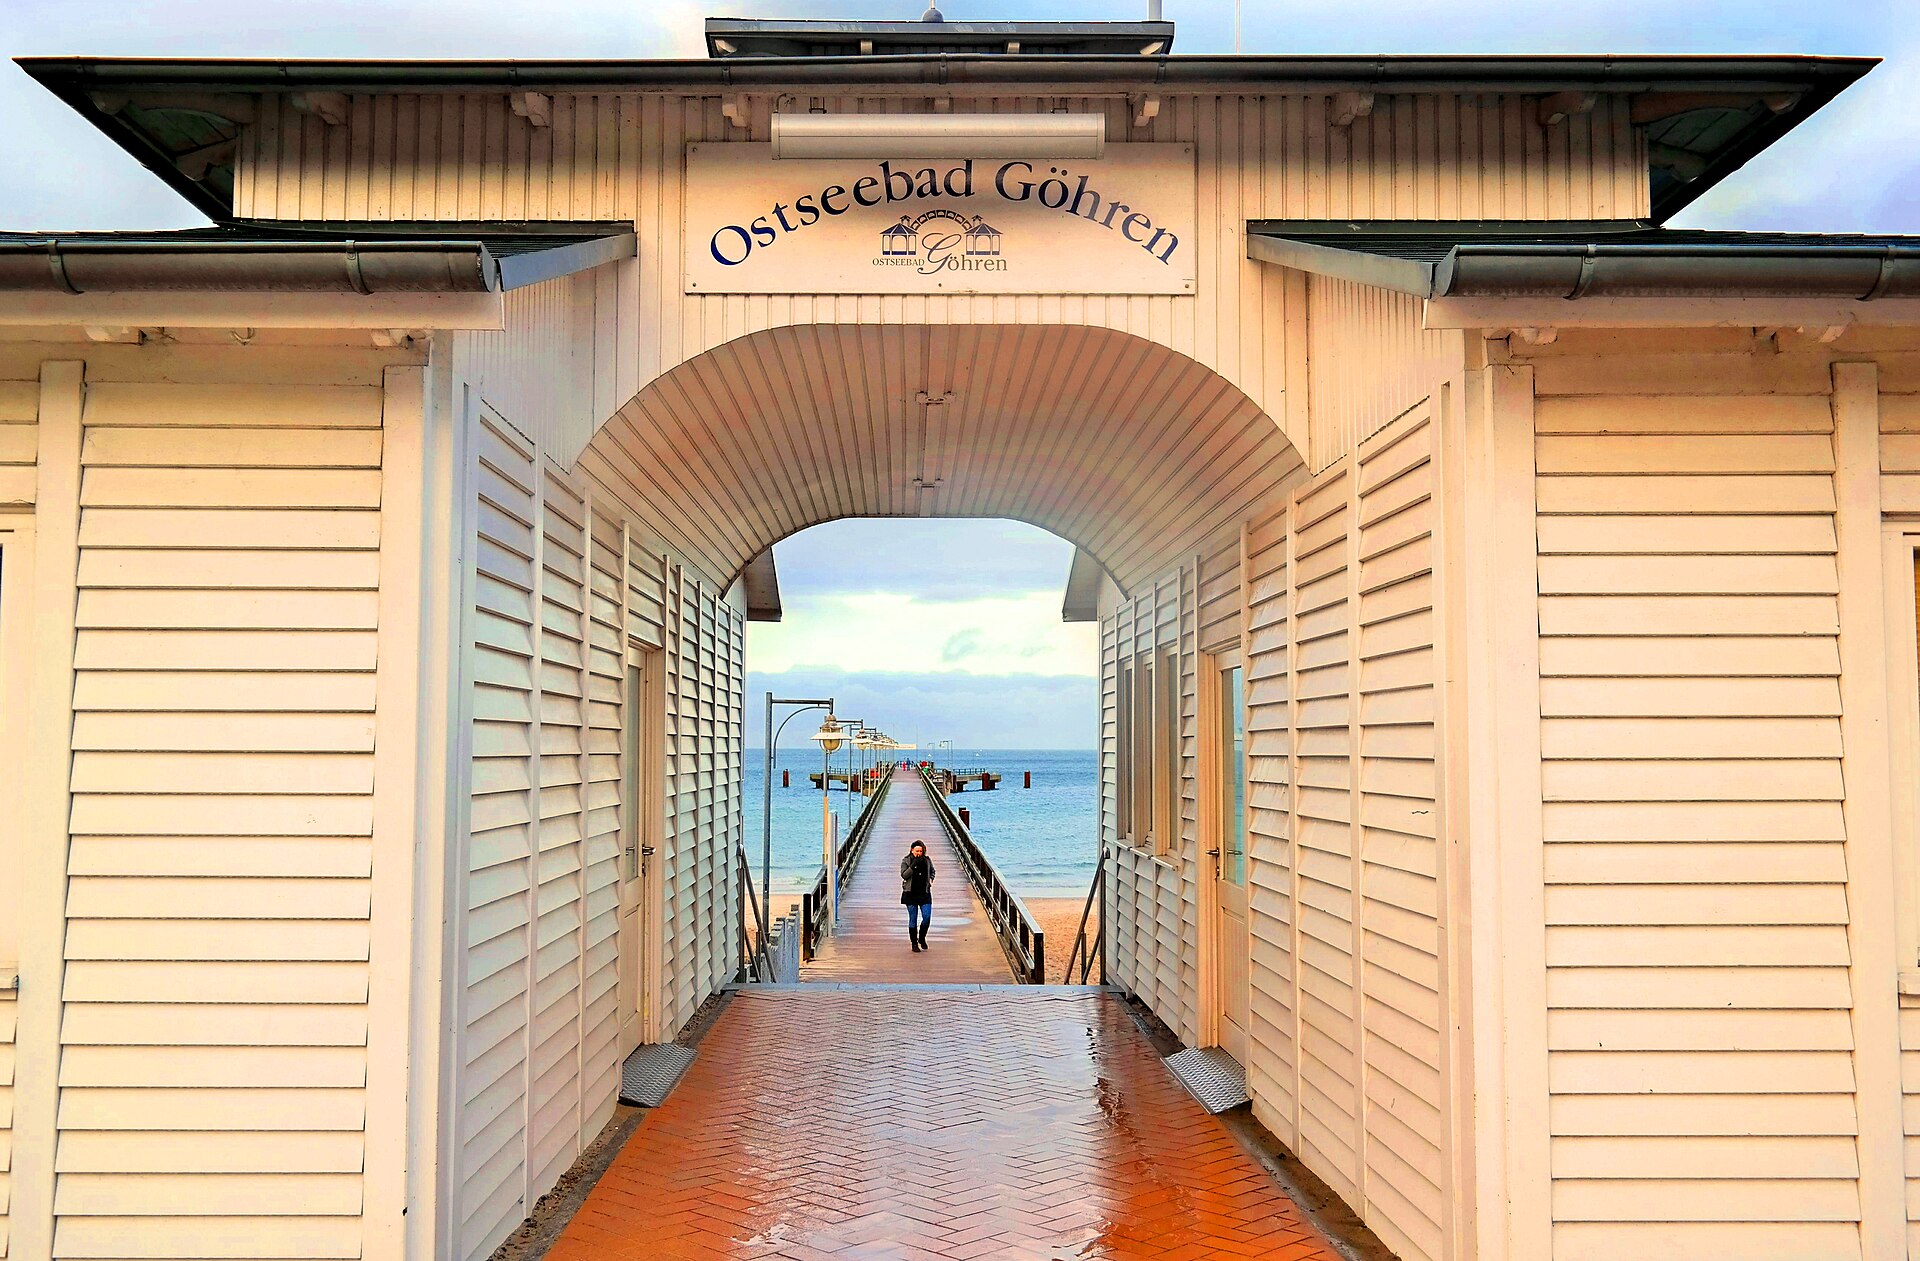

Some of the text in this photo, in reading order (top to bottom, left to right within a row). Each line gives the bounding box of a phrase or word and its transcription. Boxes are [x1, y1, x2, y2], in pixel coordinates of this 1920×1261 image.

[710, 159, 1180, 266] Ostseebad Göhren
[872, 232, 1008, 275] OSTSEEBAD Göhren
